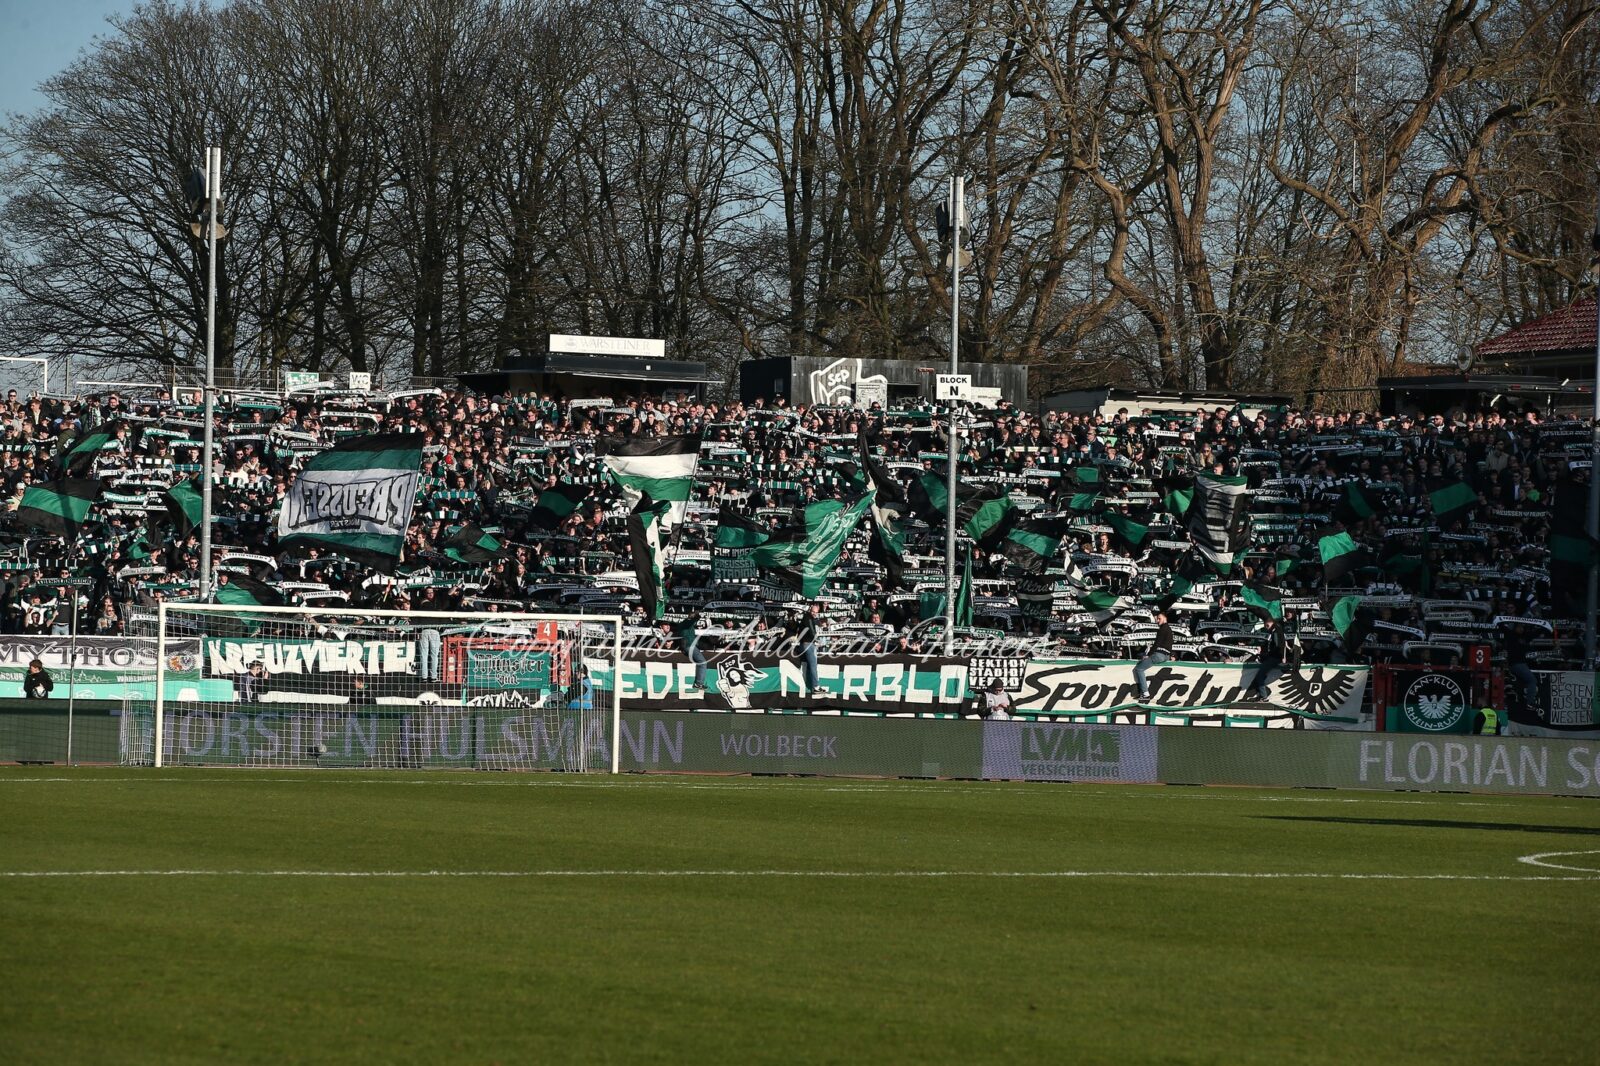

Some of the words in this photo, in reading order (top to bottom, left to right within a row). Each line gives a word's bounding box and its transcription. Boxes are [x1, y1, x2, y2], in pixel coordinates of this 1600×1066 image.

[940, 376, 968, 384] BLOCK
[950, 386, 959, 396] N
[543, 623, 551, 636] 4
[1409, 676, 1459, 696] FAN-KLUB
[1551, 684, 1593, 697] BESTEN
[1406, 706, 1462, 728] RHEIN-RUHR
[1551, 710, 1593, 723] WESTEN
[720, 733, 838, 758] WOLBECK
[1021, 763, 1120, 777] VERSICHERUNG
[1359, 740, 1548, 788] FLORIAN
